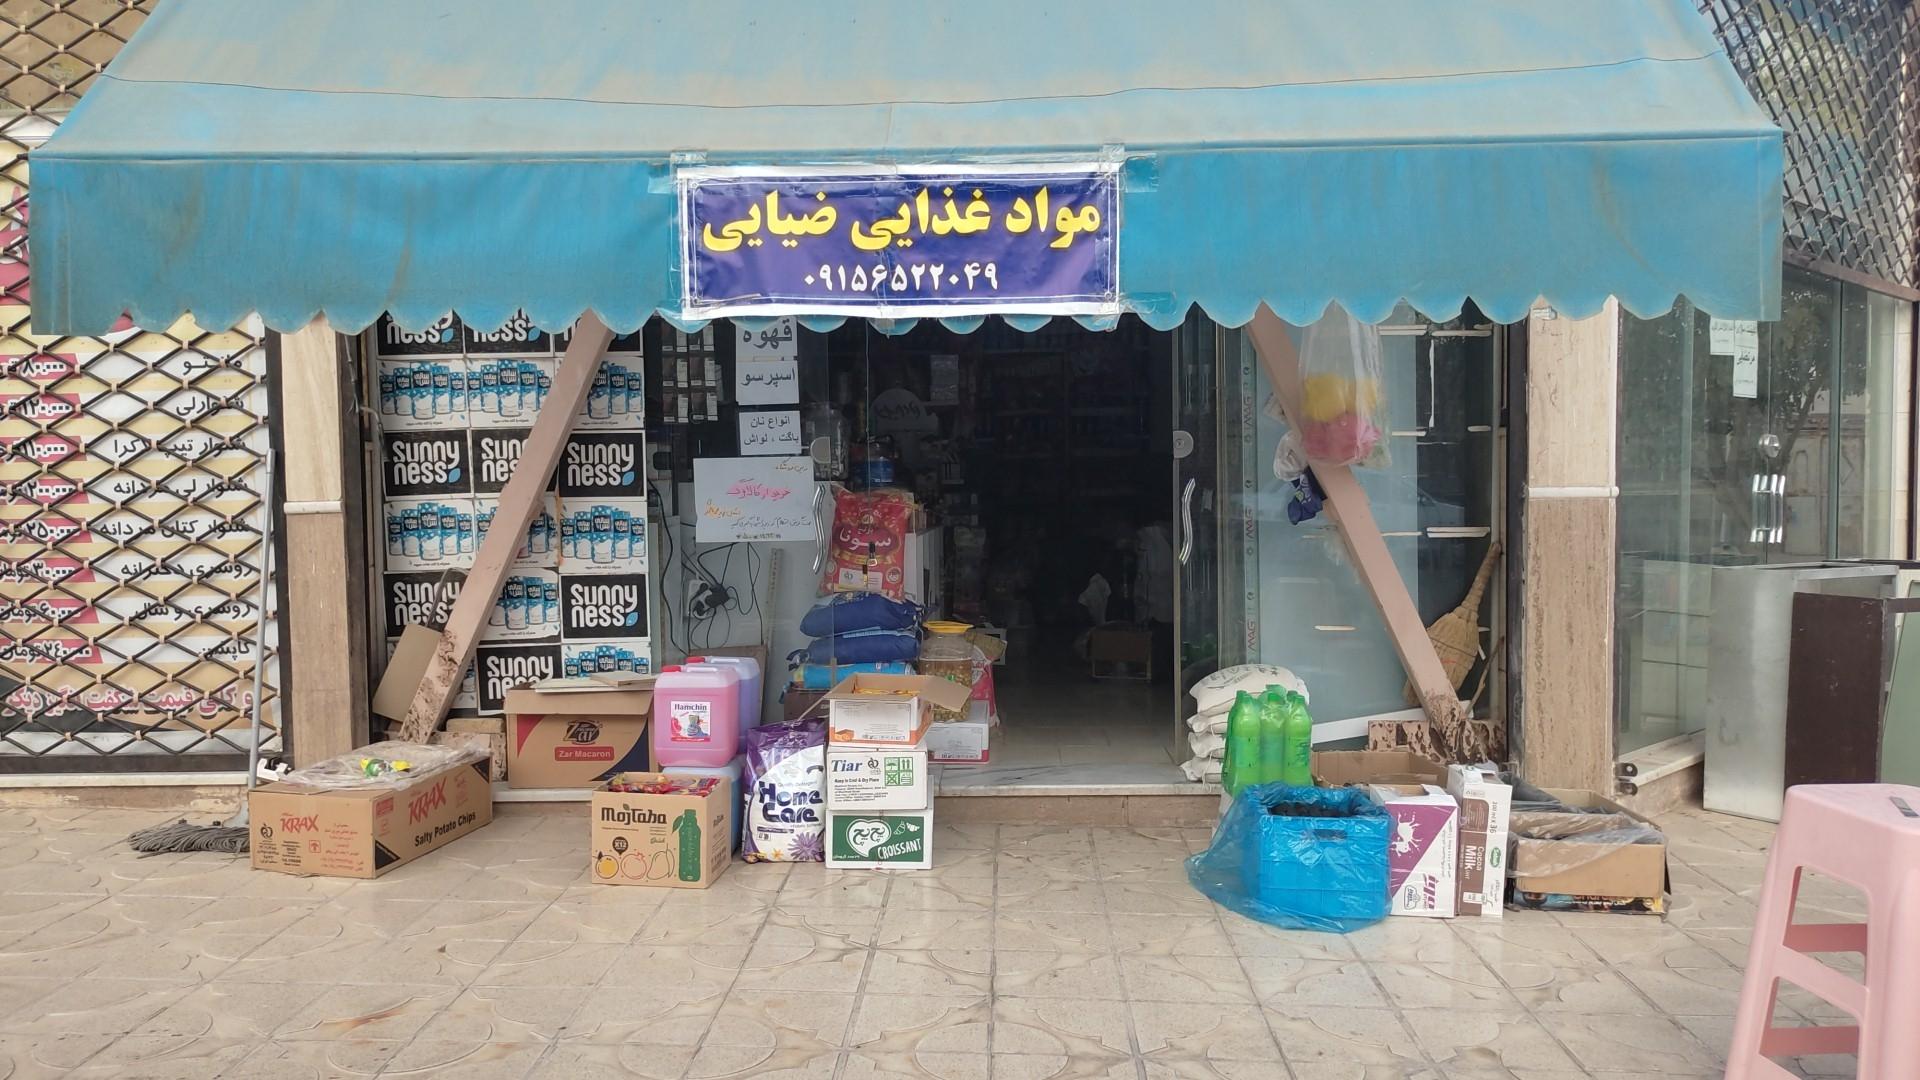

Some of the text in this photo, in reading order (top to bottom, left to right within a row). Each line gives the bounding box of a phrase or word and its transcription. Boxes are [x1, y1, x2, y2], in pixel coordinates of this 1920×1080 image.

[702, 185, 1100, 251] مواد غذایی ضیایی
[804, 262, 998, 292] ۰۹۱۵۶۵۲۲۰۴۹
[743, 318, 793, 350] قهوه
[741, 367, 796, 387] اسپرسو
[750, 416, 790, 429] انواع نان
[481, 438, 528, 460] sun
[744, 433, 768, 445] لواش
[394, 461, 448, 485] ness
[568, 464, 620, 487] ness
[572, 605, 625, 628] ness
[674, 703, 707, 711] Hamchin
[558, 750, 611, 758] Zar Macaron
[831, 759, 863, 773] Tiar
[408, 775, 448, 825] KRAX
[758, 780, 824, 807] Home
[280, 814, 319, 833] KRAX
[762, 802, 819, 823] Care
[414, 811, 477, 848] Salty Potato Chips
[877, 838, 922, 860] CROISSANT
[1464, 845, 1477, 870] Milk
[1476, 846, 1485, 871] Cocoa
